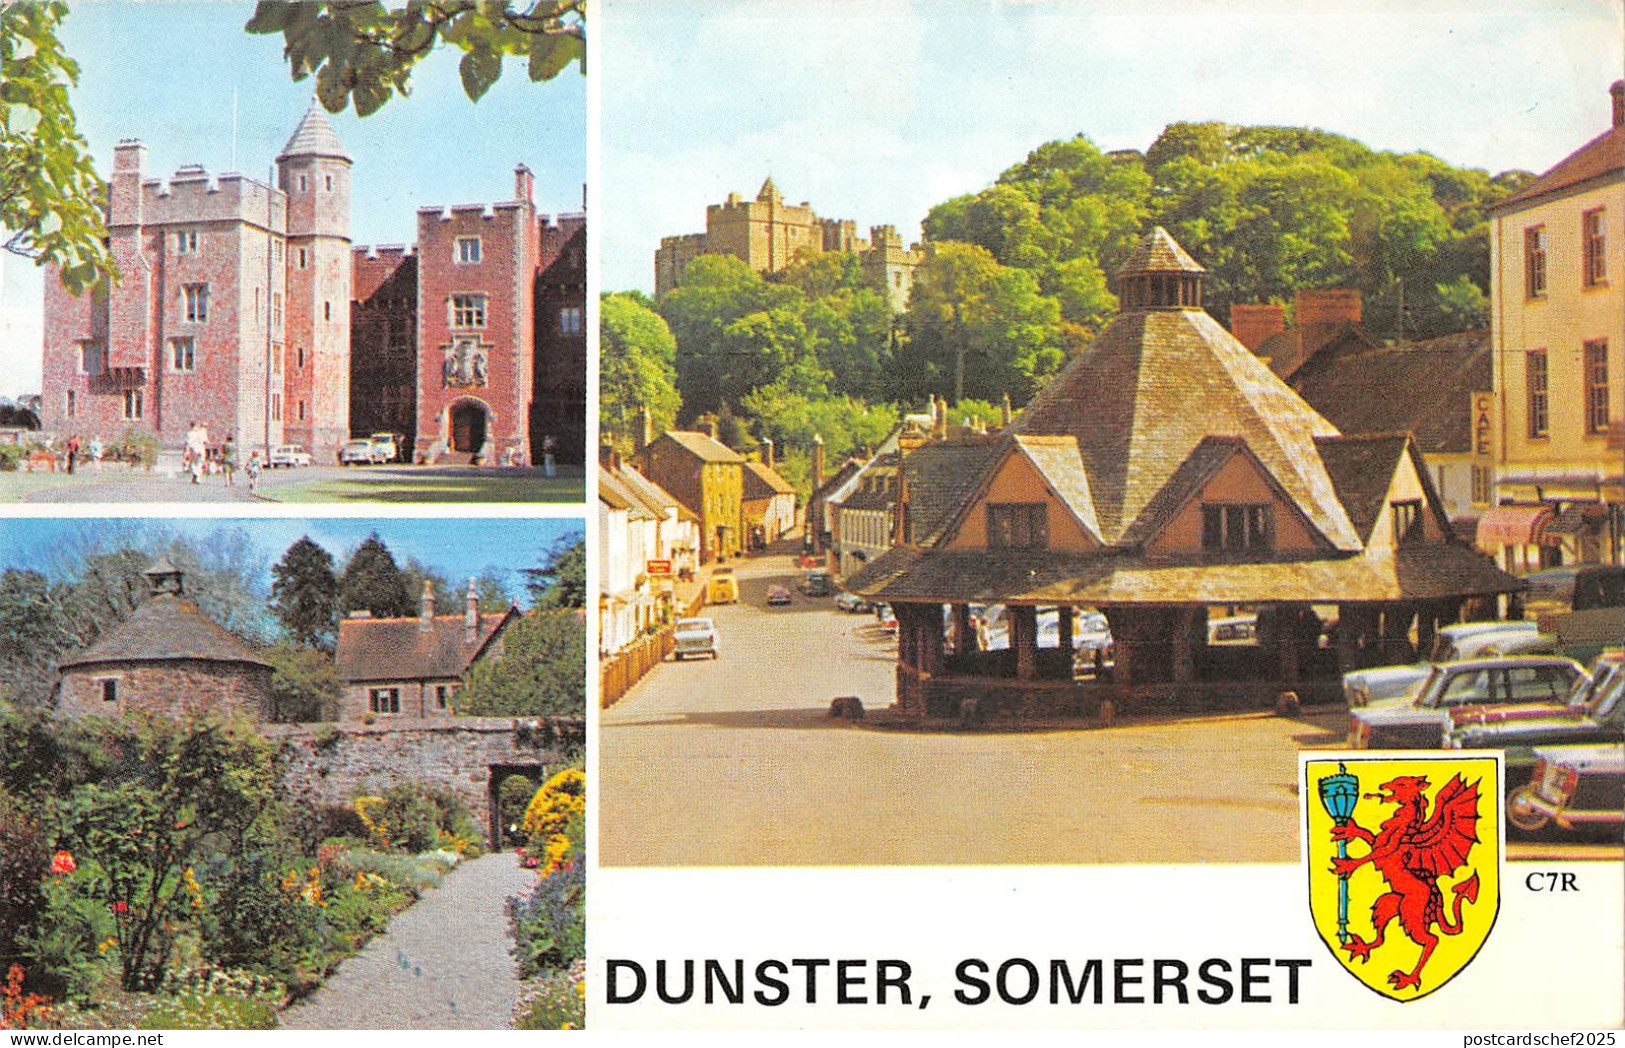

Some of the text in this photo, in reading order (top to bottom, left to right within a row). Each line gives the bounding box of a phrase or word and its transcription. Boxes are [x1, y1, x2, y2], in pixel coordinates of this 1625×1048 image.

[1477, 398, 1490, 455] CAFE
[1525, 872, 1579, 892] C7R
[606, 957, 1313, 1010] DUNSTER, SOMERSET
